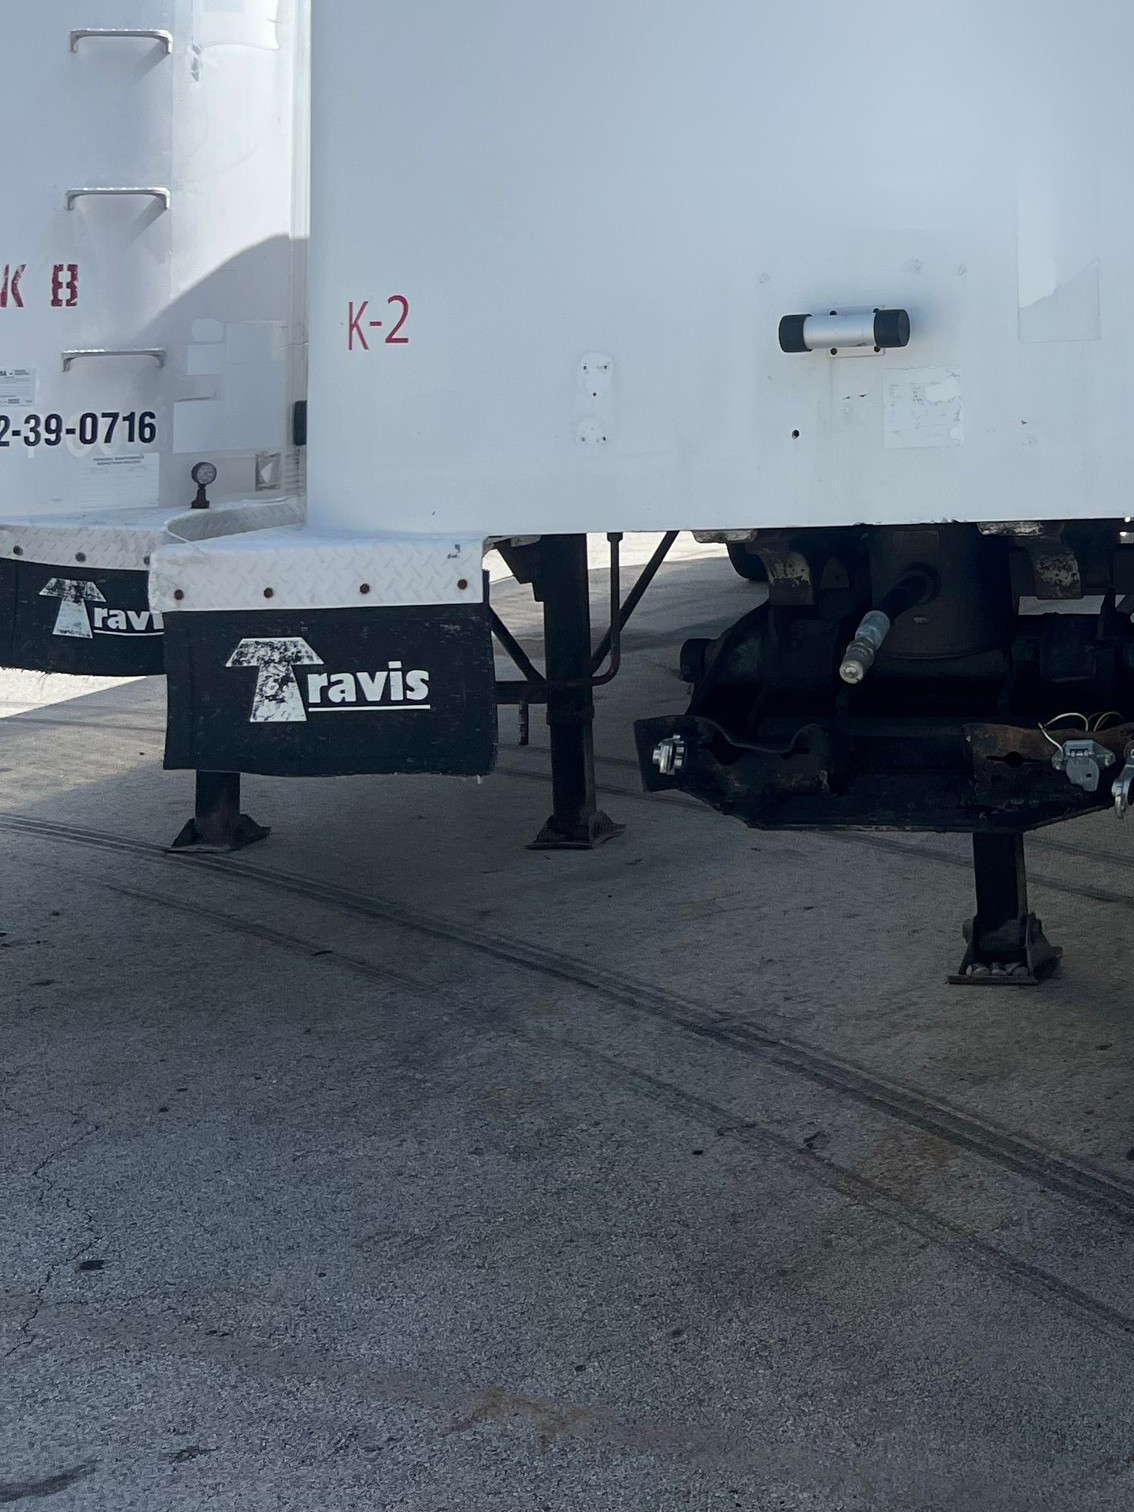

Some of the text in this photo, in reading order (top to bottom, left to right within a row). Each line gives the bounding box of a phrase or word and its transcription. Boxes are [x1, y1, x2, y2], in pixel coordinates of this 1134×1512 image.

[347, 295, 410, 351] K-2
[39, 577, 164, 639] Travi
[226, 636, 430, 722] Travis
